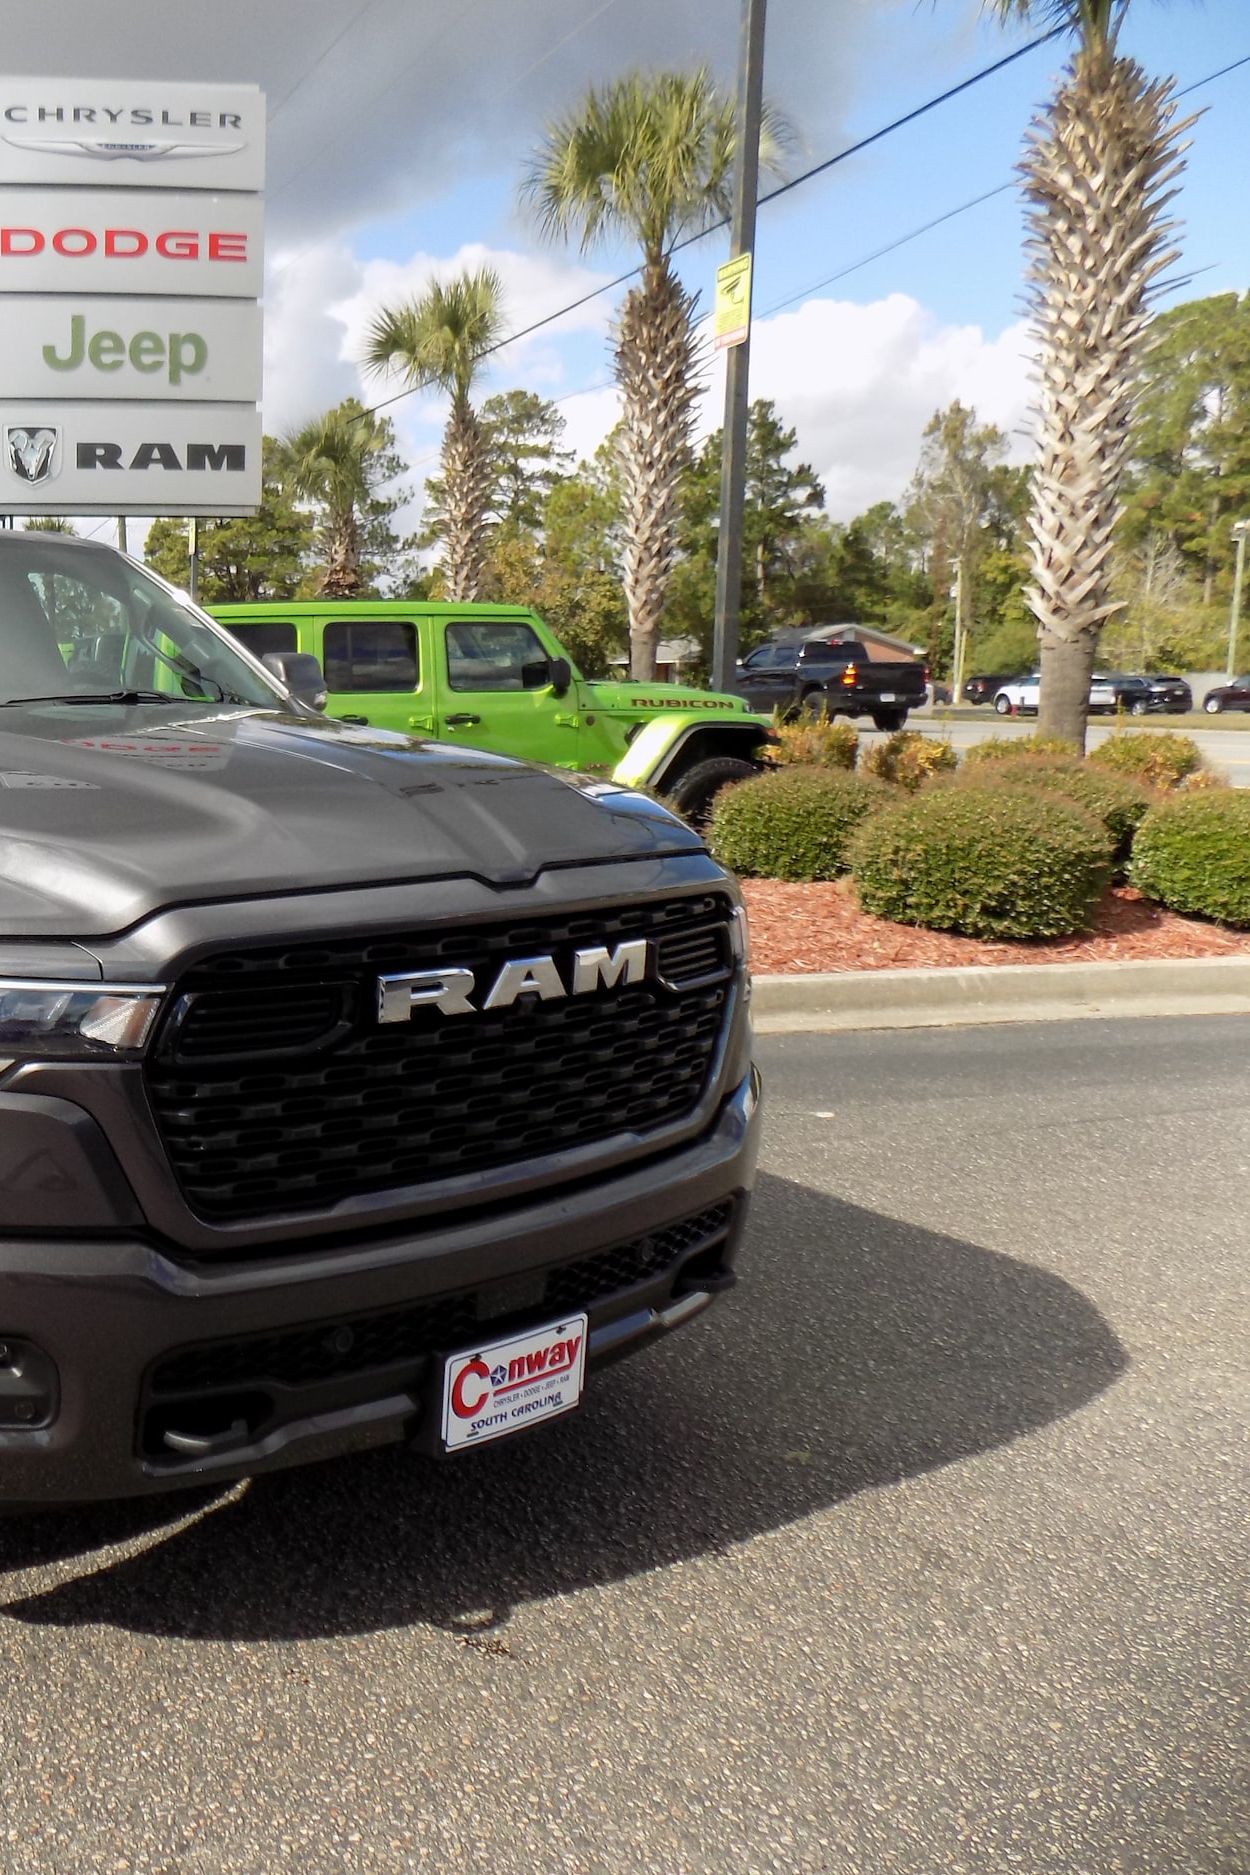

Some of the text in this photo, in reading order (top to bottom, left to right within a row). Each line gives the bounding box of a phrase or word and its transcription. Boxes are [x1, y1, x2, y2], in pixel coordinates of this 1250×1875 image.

[4, 106, 242, 129] CHRYSLER
[0, 227, 248, 263] DODGE
[41, 314, 208, 386] Jeep
[76, 442, 246, 471] RAM
[631, 698, 734, 710] RUBICON
[378, 938, 648, 1024] RAM
[470, 1391, 563, 1431] SOUTH CAROLINA
